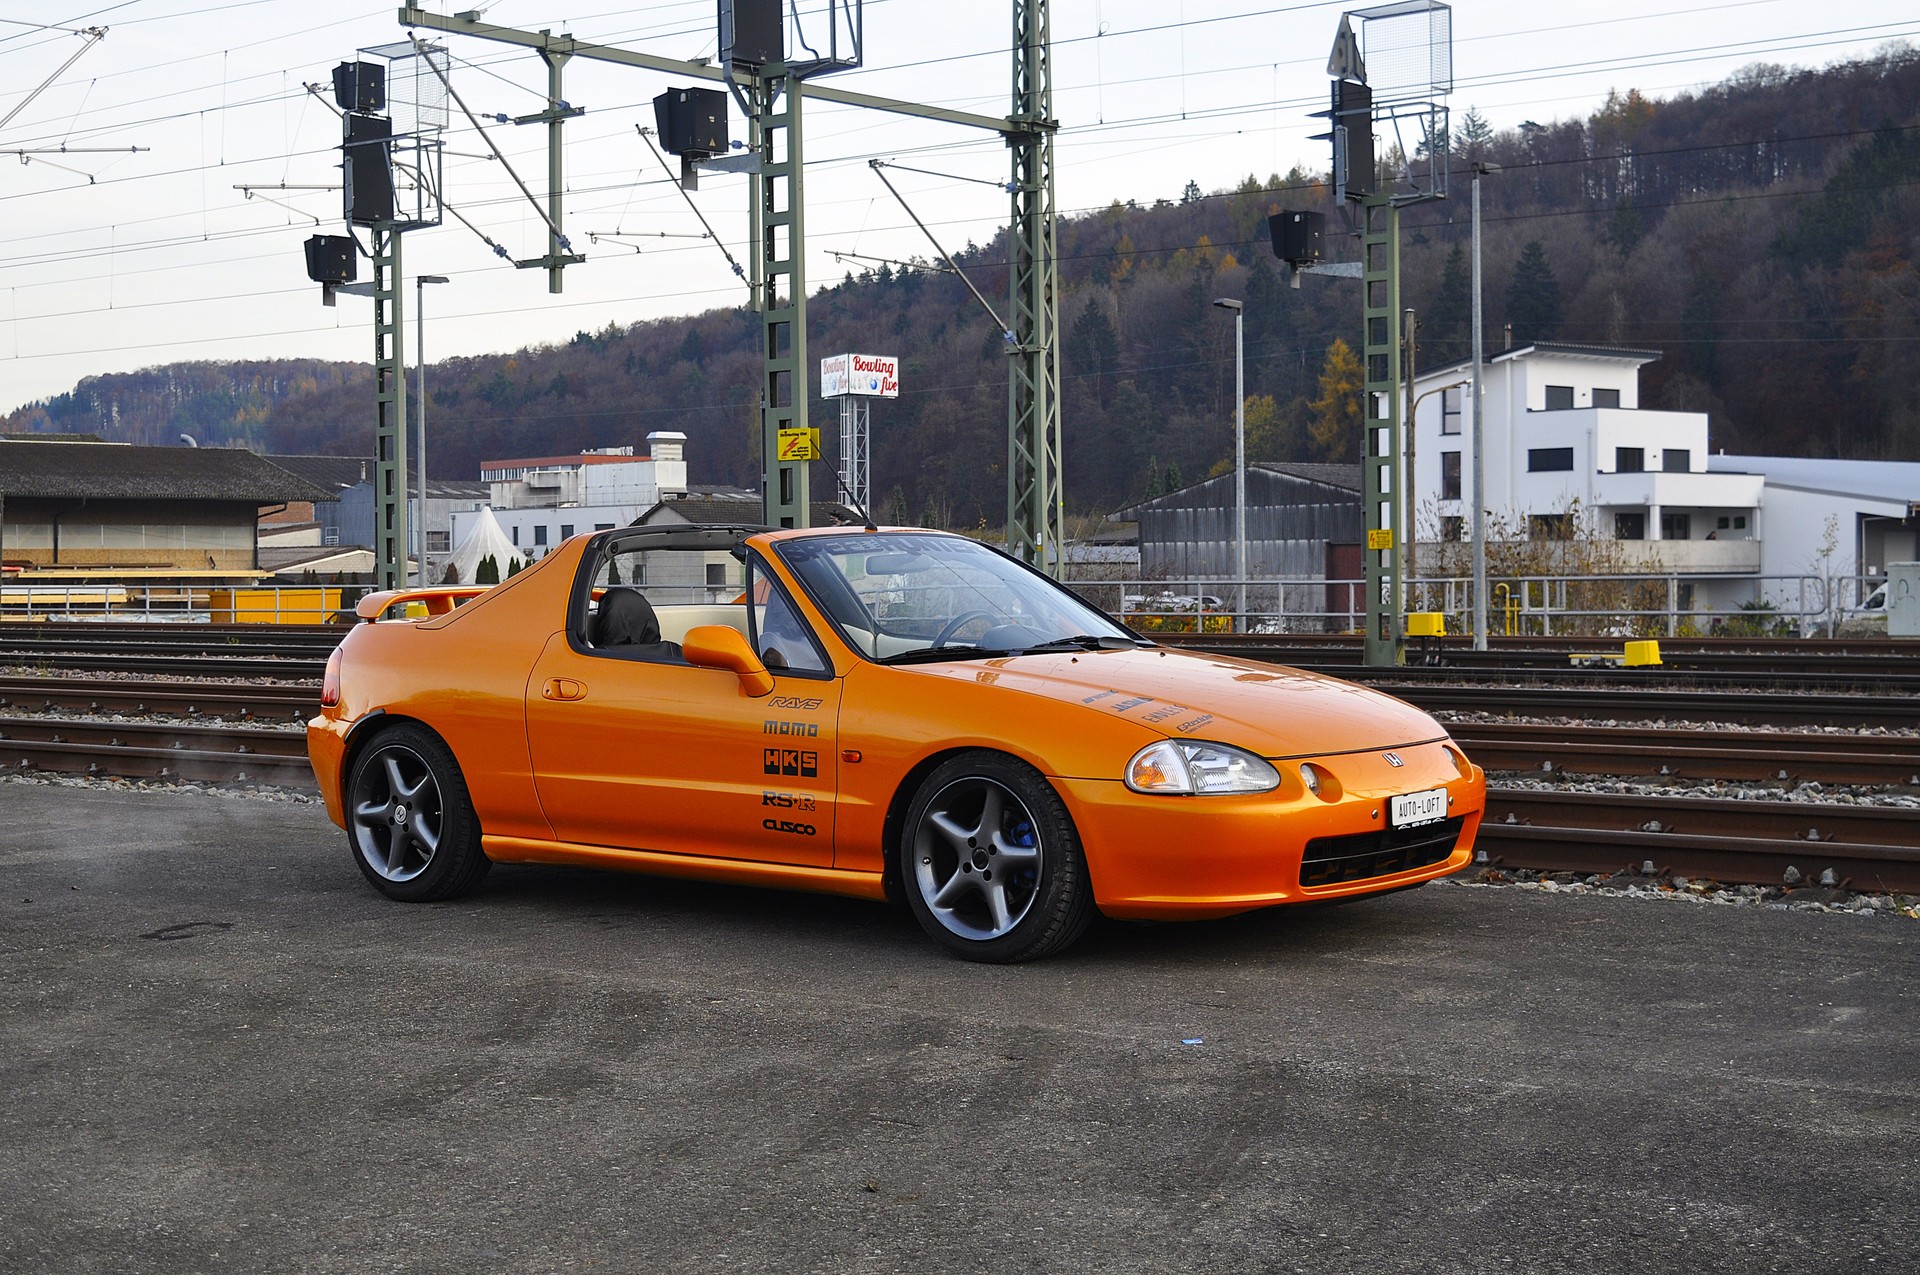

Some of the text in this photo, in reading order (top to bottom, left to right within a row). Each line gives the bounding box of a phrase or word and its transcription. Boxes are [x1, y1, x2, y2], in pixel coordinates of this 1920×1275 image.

[853, 355, 894, 378] Bowling
[880, 376, 898, 395] five
[768, 696, 823, 709] RAYS
[764, 749, 817, 773] HKS
[1398, 797, 1440, 818] AUTO-LOFT
[763, 819, 816, 836] CUSCO
